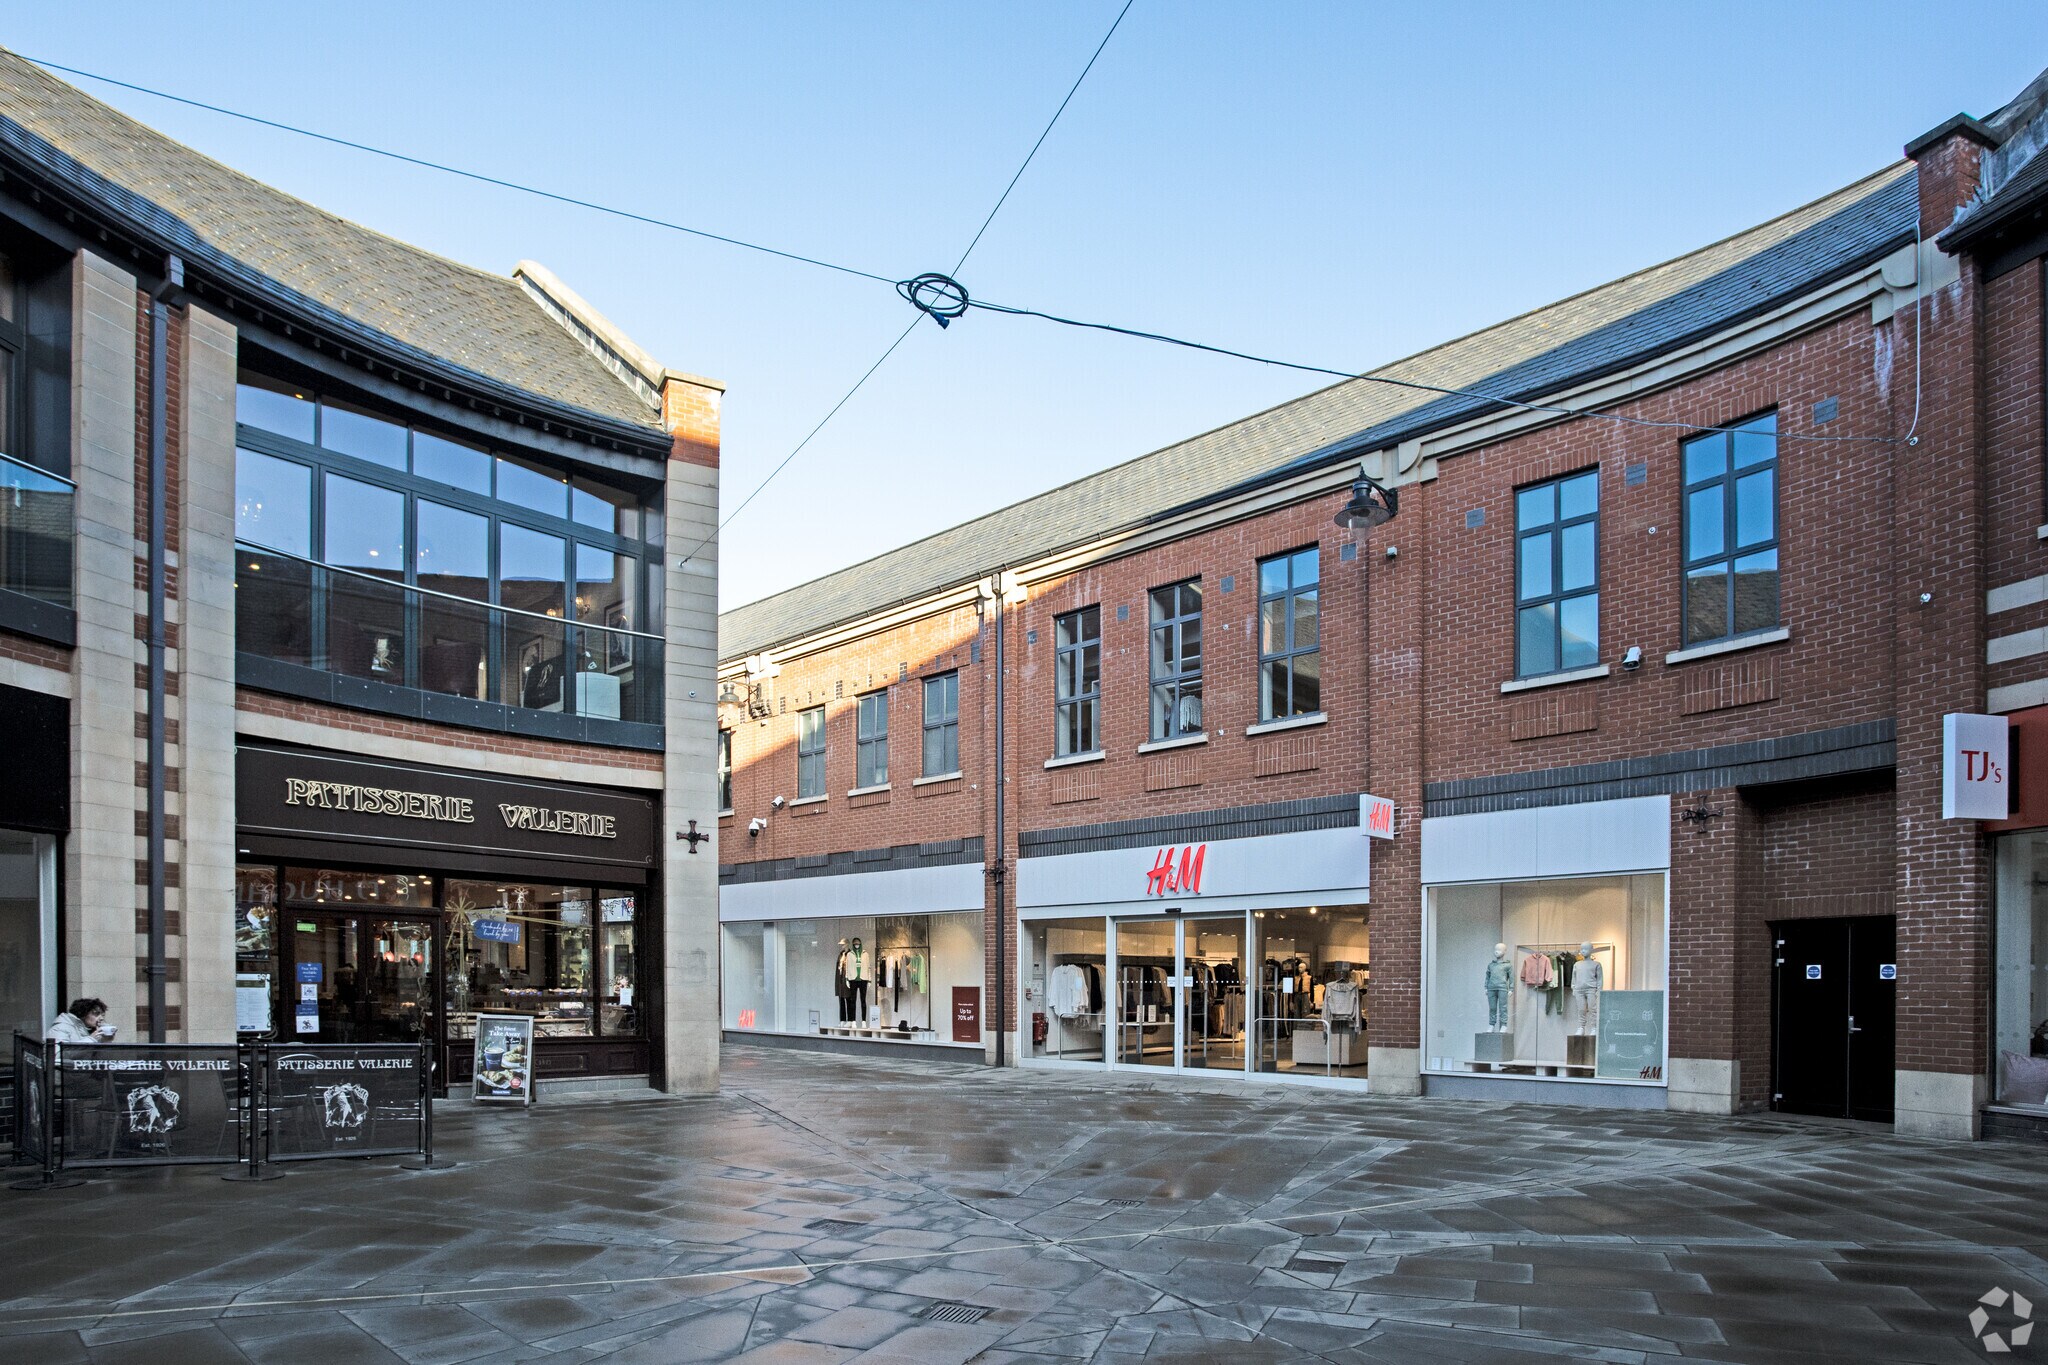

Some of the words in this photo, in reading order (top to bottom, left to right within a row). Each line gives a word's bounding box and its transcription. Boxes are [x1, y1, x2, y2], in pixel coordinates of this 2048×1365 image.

[1961, 750, 2002, 783] TJ's
[285, 778, 475, 823] PATISSERIE
[498, 803, 616, 838] VALERIE
[1369, 802, 1391, 833] H&M
[1146, 843, 1207, 897] H&M
[73, 1059, 163, 1071] PATISSERIE
[167, 1060, 230, 1071] VALERIE
[277, 1059, 355, 1070] PATISSERIE
[358, 1058, 413, 1069] VALERIE
[1639, 1065, 1661, 1079] H&M
